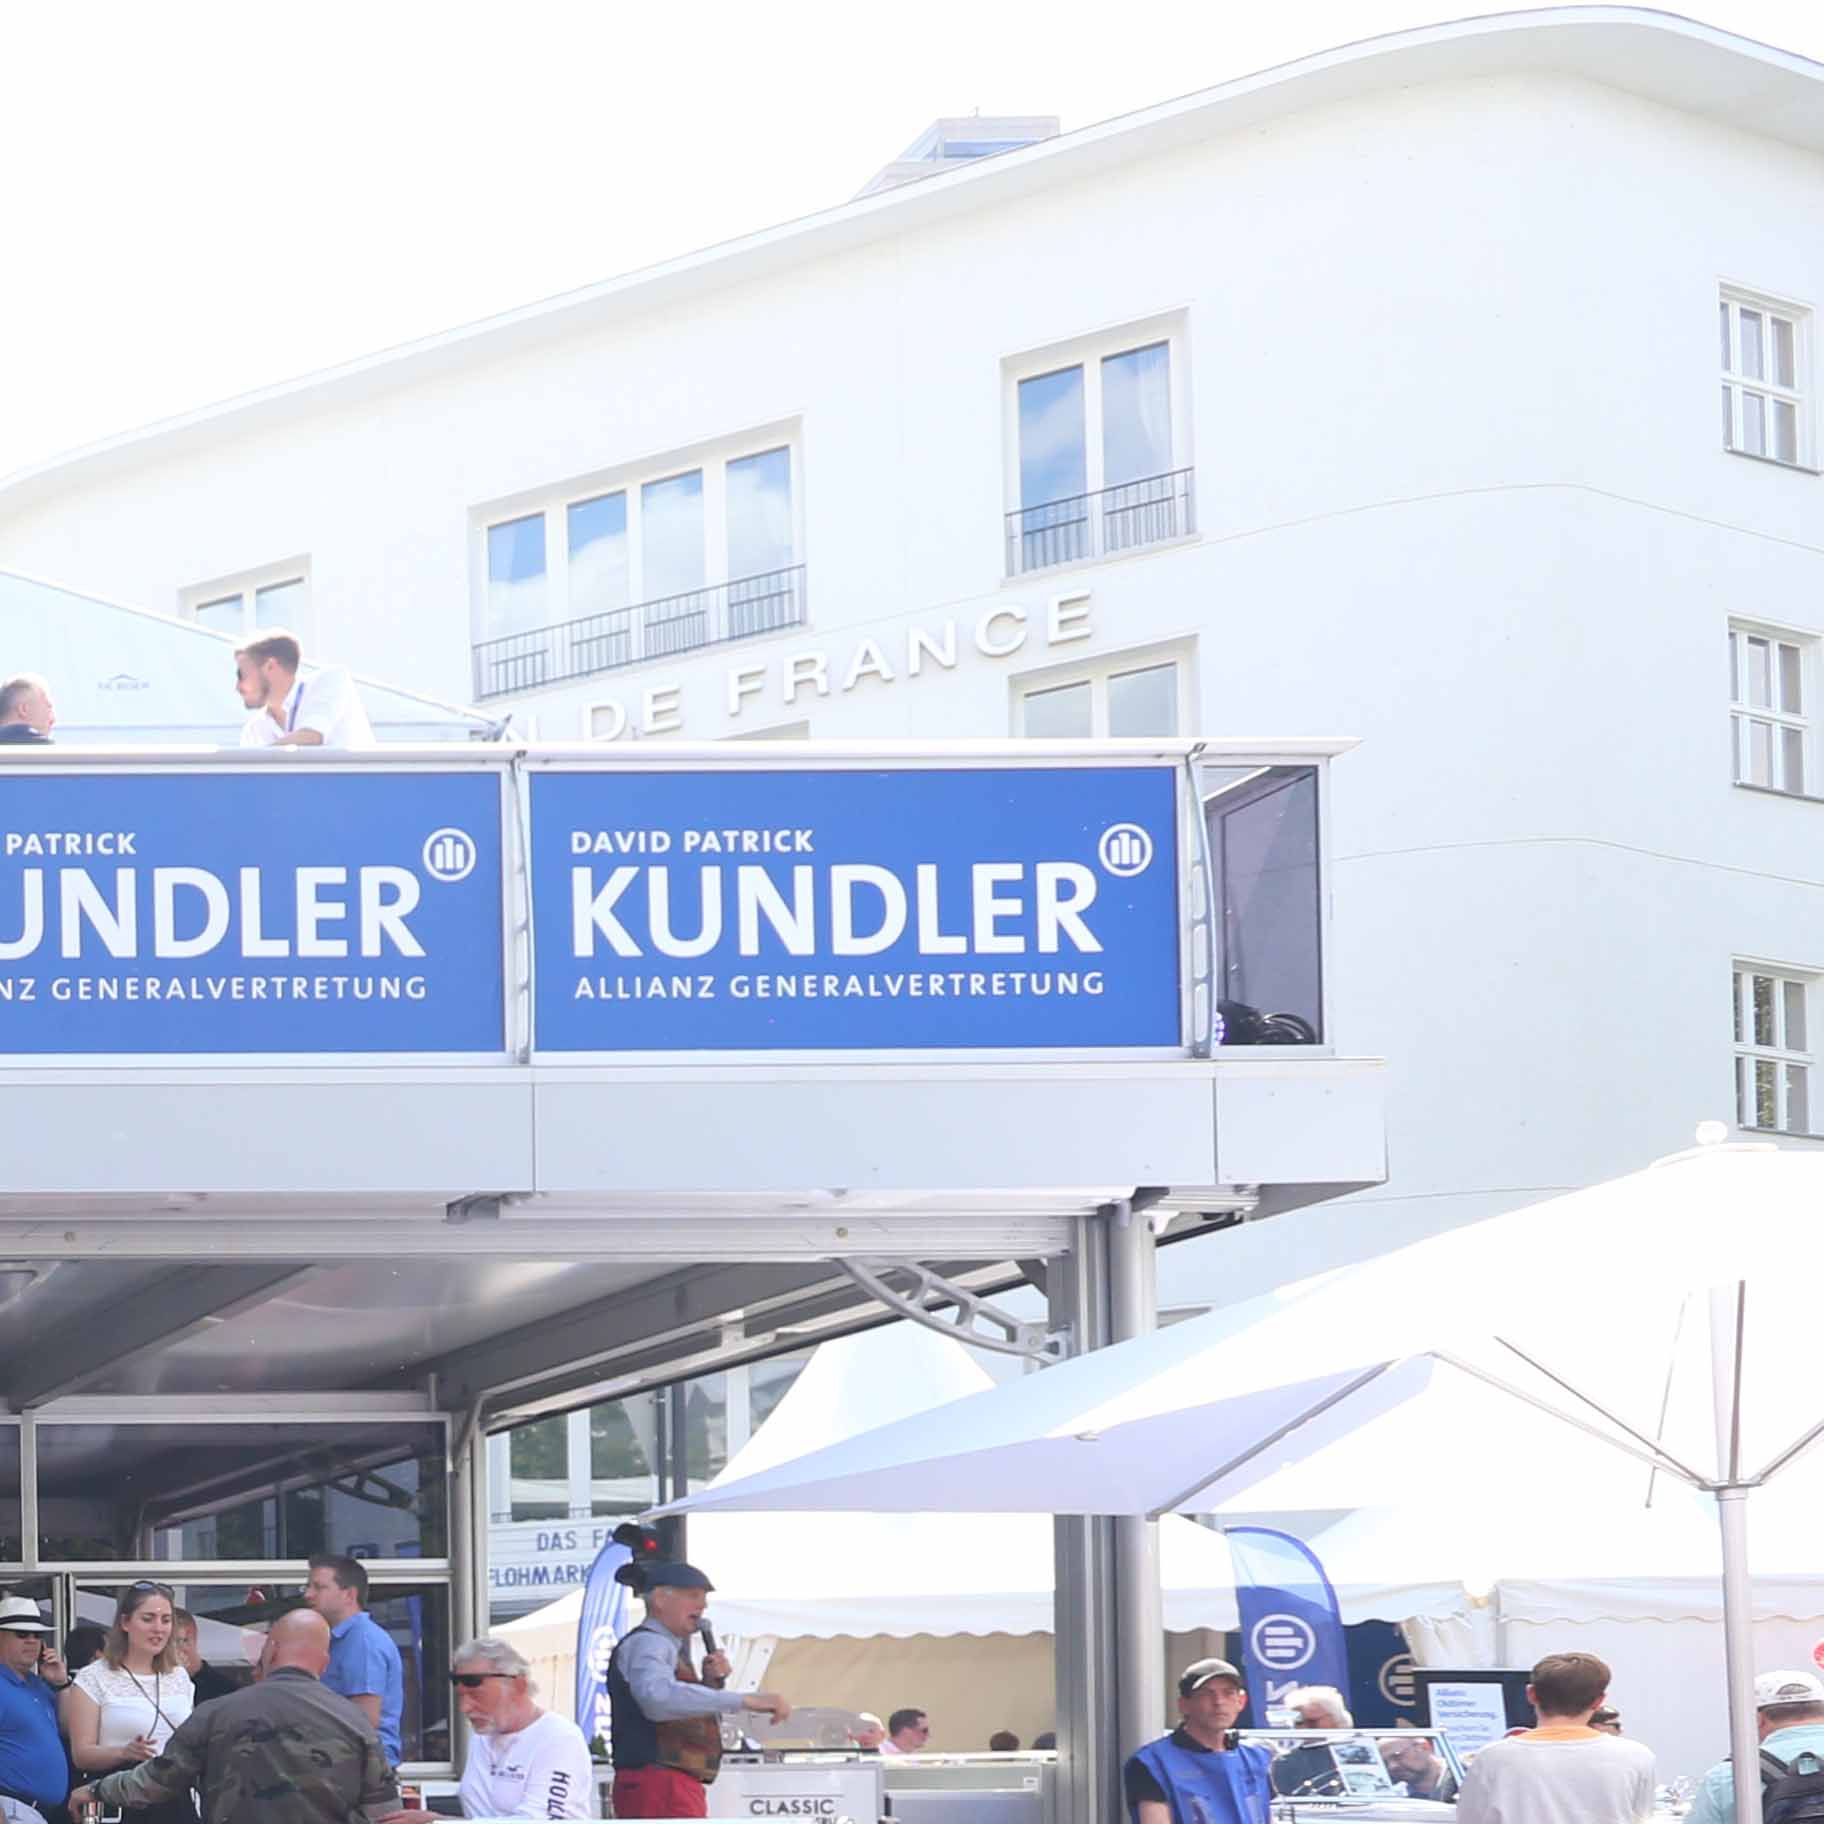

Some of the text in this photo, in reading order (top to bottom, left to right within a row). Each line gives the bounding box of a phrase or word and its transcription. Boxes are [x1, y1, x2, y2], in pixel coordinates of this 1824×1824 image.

[582, 590, 1093, 742] DE FRANCE
[6, 832, 137, 856] PATRICK
[571, 829, 814, 854] DAVID PATRICK
[572, 862, 1104, 957] KUNDLER
[51, 976, 427, 1001] GENERALVERTRETUNG
[575, 971, 1106, 1000] ALLIANZ GENERALVERTRETUNG
[537, 1530, 577, 1551] DAS
[489, 1565, 591, 1587] FLOHMARK
[750, 1799, 835, 1815] CLASSIC
